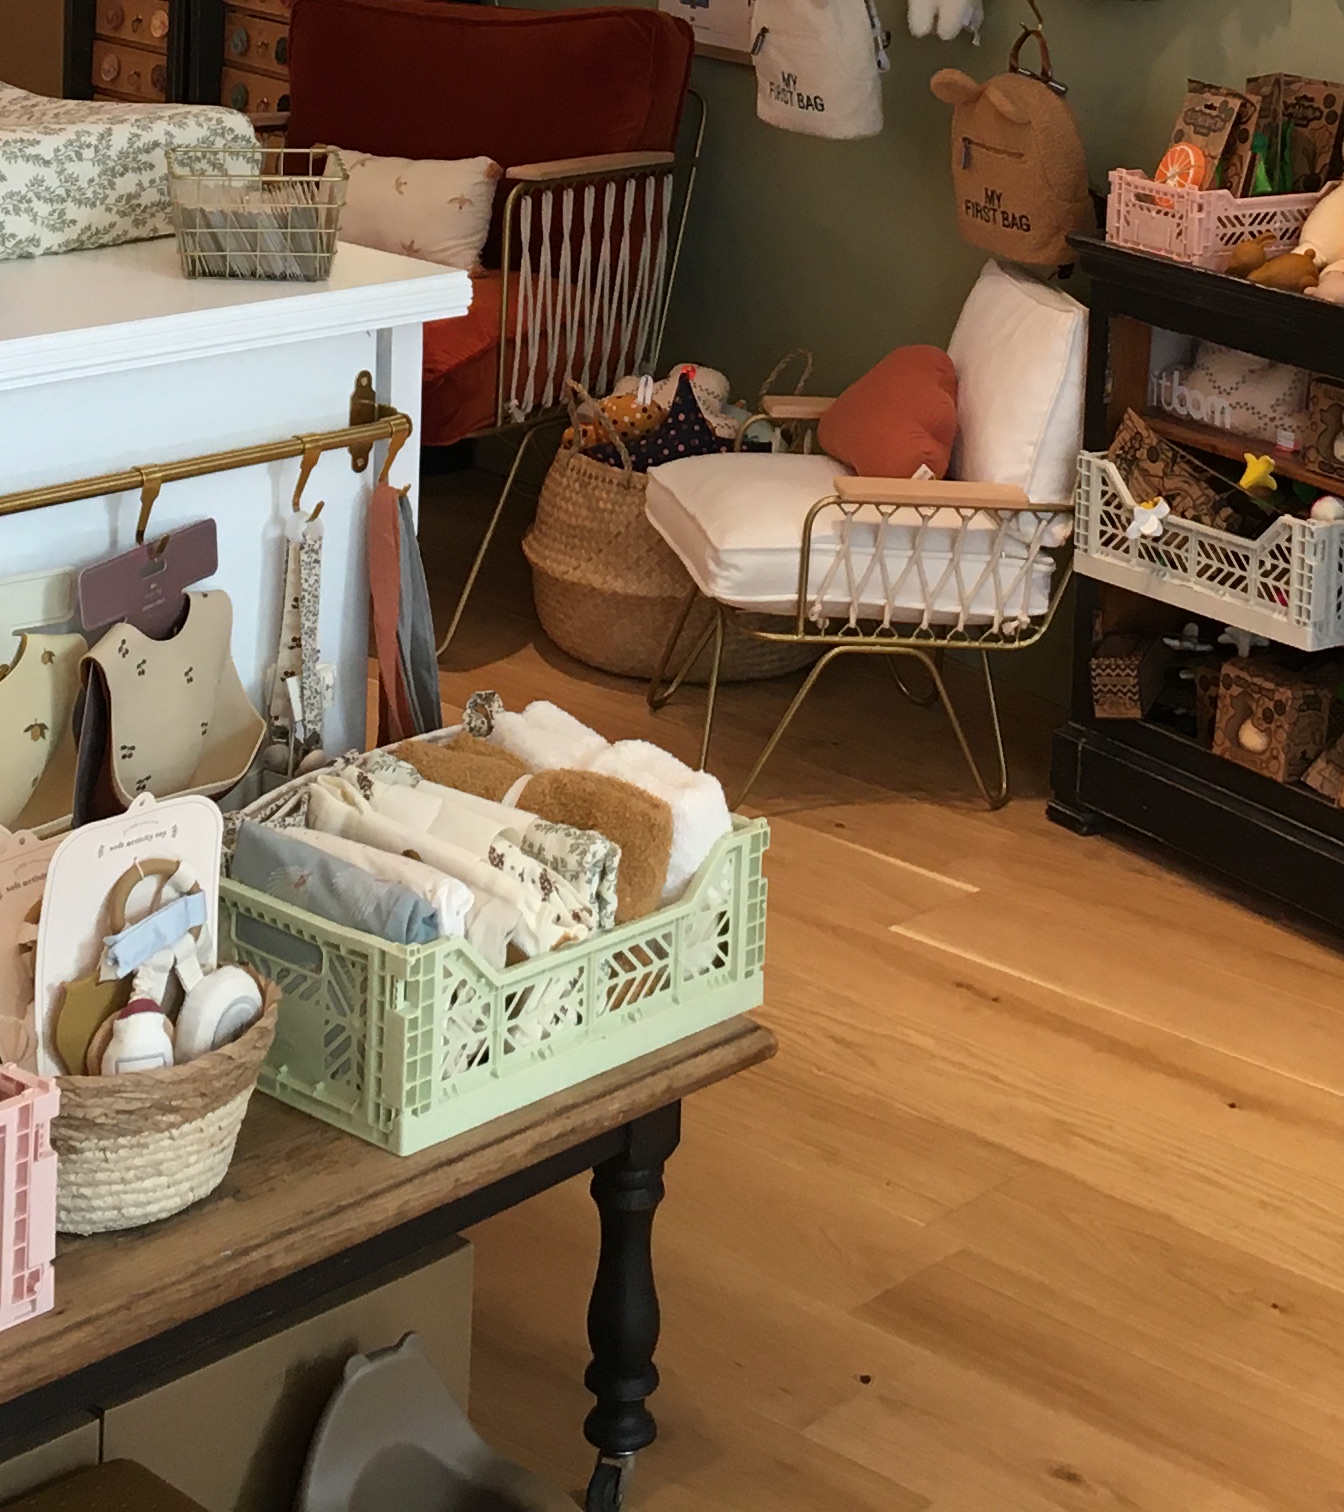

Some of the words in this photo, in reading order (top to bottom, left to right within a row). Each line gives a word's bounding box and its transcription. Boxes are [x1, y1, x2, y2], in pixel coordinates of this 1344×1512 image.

[781, 70, 798, 91] MY
[797, 92, 826, 113] BAG
[984, 186, 1003, 209] MY
[965, 199, 998, 225] FIRST
[1001, 210, 1031, 233] BAG
